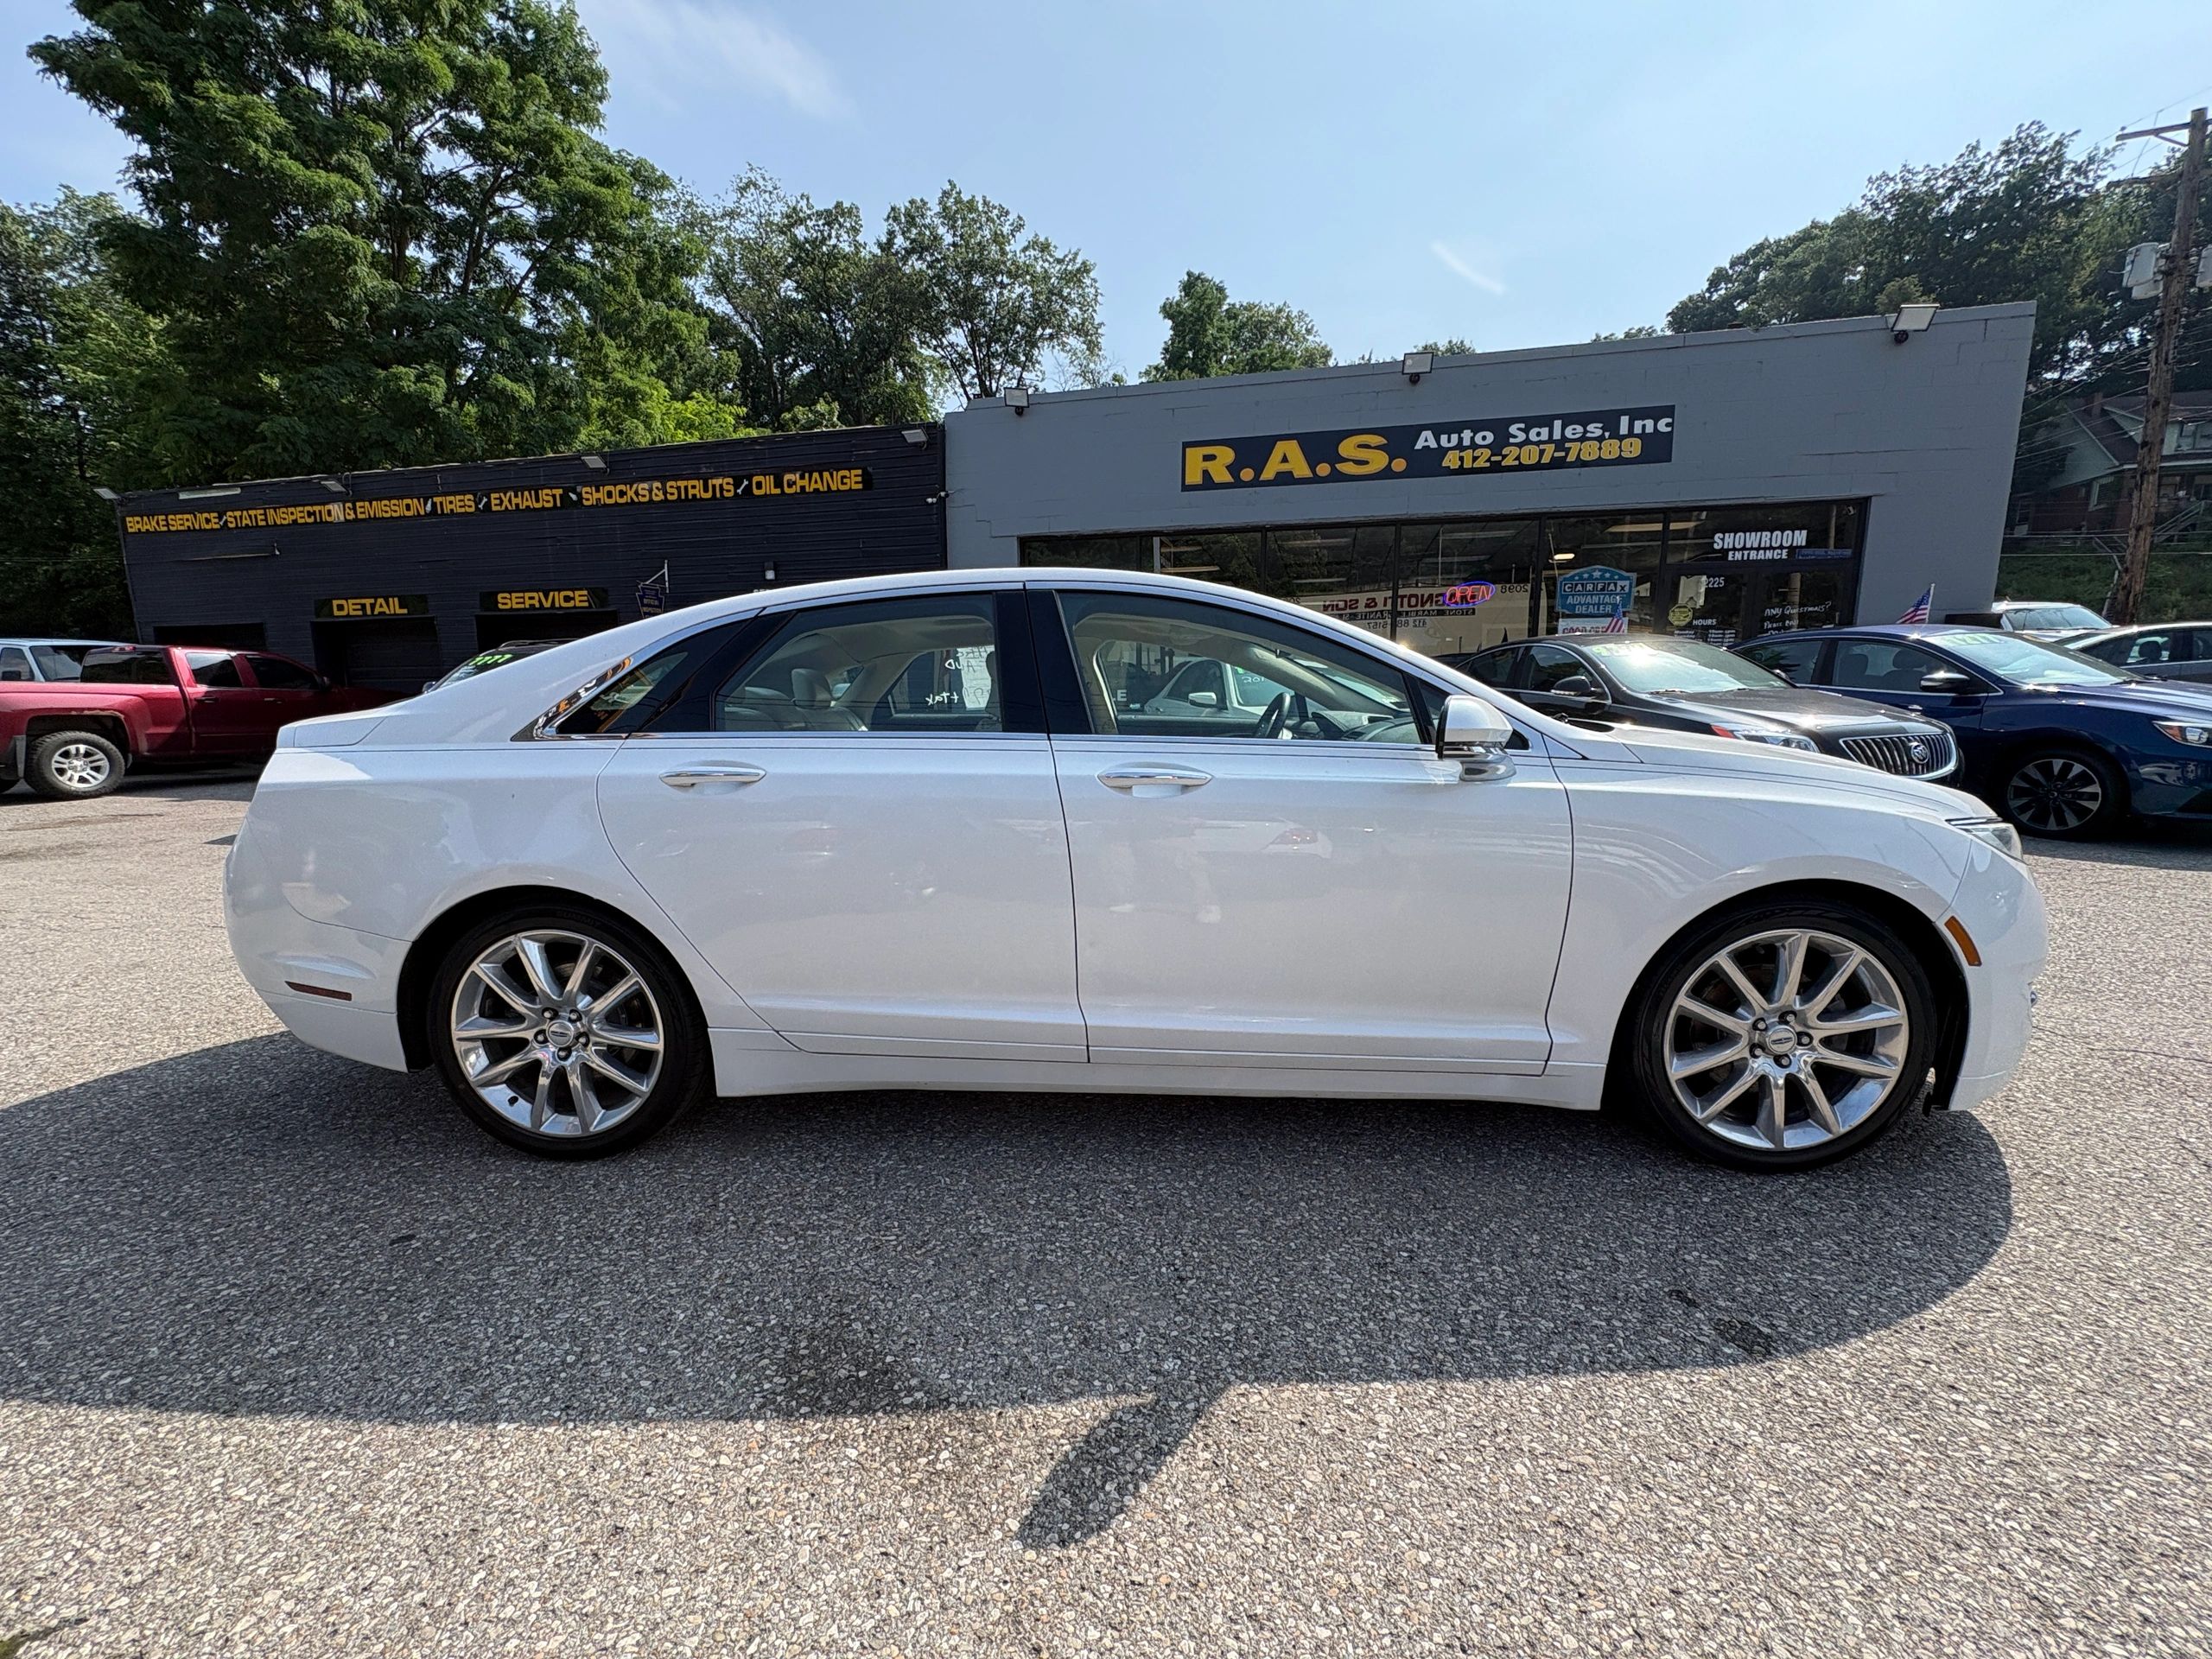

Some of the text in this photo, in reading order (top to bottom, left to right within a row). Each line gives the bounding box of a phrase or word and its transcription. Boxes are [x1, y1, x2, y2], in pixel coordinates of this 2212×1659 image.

[1185, 415, 1673, 486] R.A.S. Auto Sales, Inc
[1441, 437, 1642, 469] 412-207-7889
[125, 469, 863, 532] BRAKE SERVICE STATE INSPECTION & EMISSION TIRES EXHAUST SHOCKS & STRUTS OIL CHANGE
[1713, 530, 1808, 550] SHOWROOM
[1728, 549, 1789, 562] ENTRANCE
[1563, 582, 1629, 594] CARFAX
[1704, 576, 1726, 588] 2225
[497, 590, 589, 609] SERVICE
[1446, 585, 1494, 603] OPEN
[332, 597, 408, 616] DETAIL
[1575, 605, 1612, 614] DEALER
